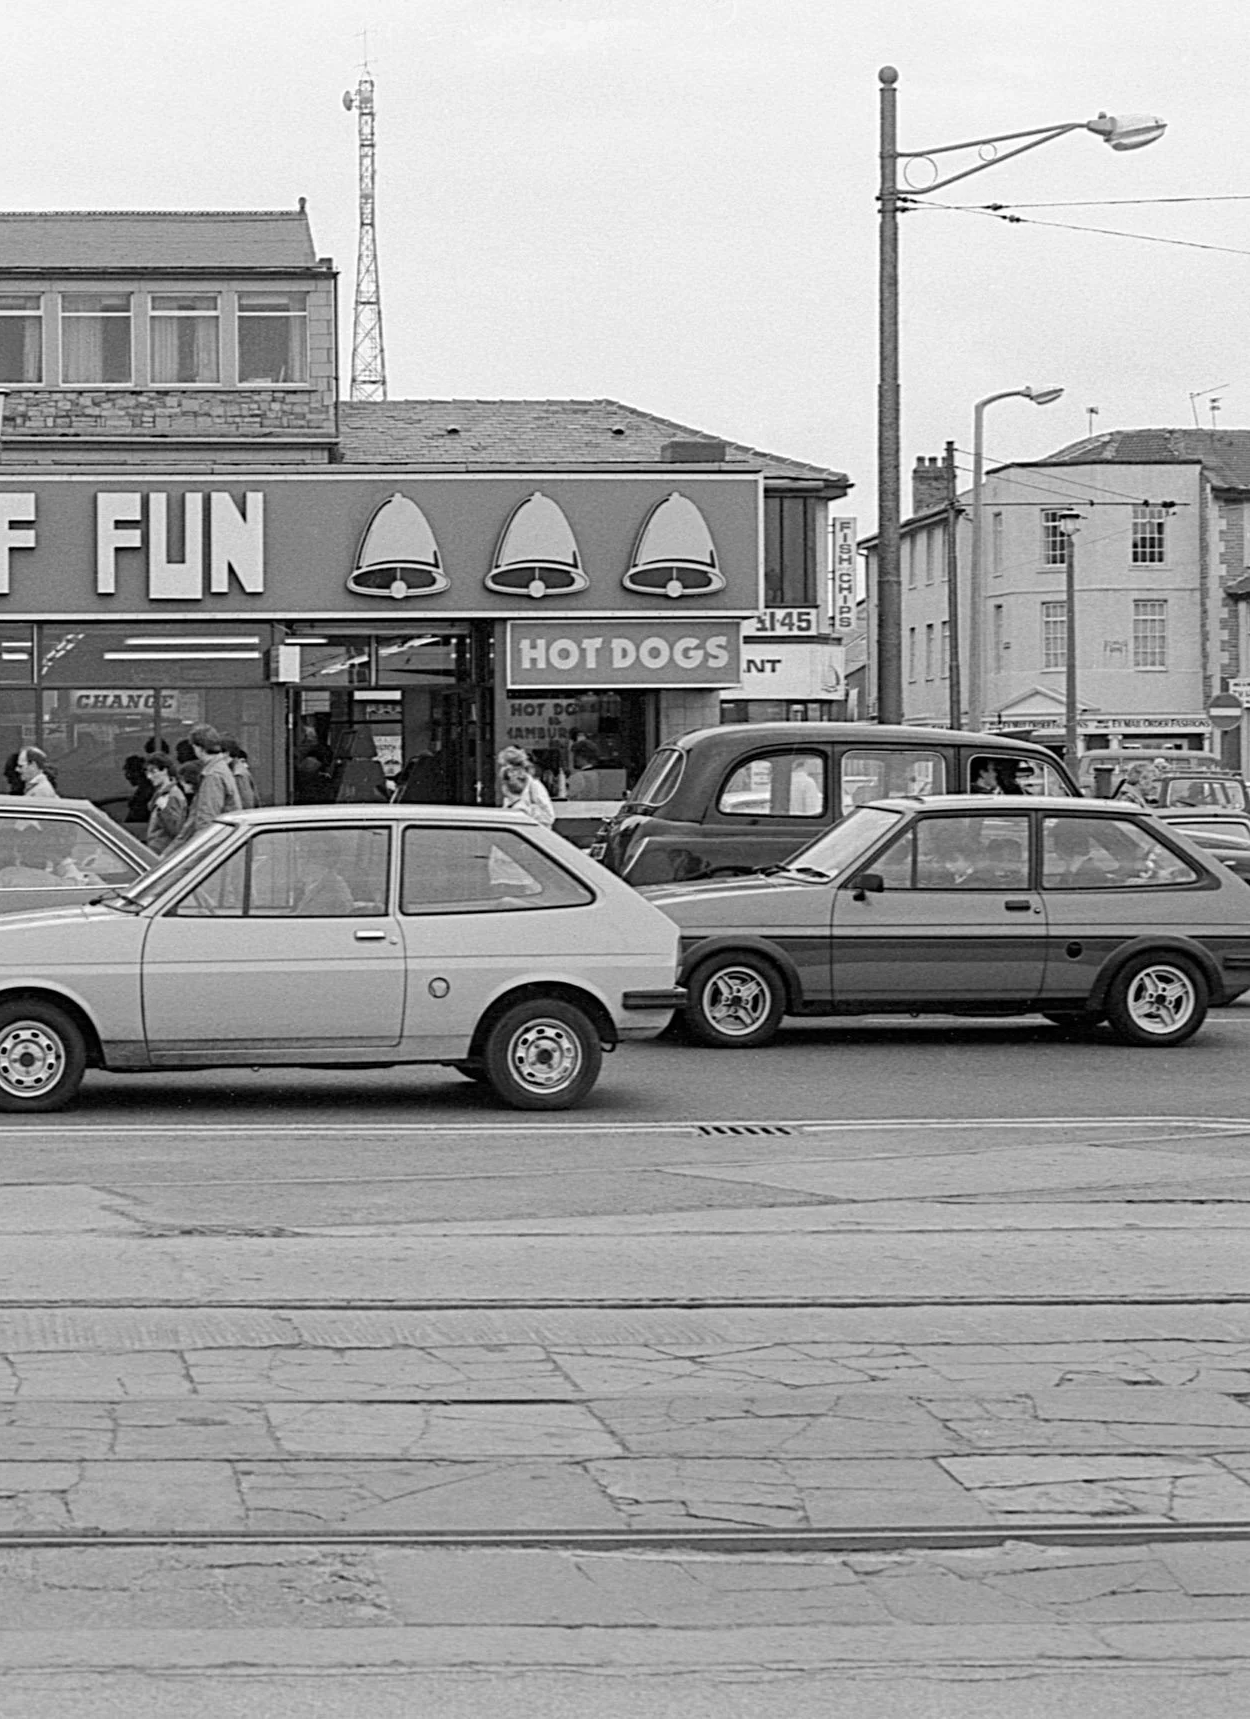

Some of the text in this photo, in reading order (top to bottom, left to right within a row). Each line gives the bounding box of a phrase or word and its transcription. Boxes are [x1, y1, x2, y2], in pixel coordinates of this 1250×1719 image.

[96, 490, 265, 600] FUN
[838, 521, 853, 565] FISH
[838, 572, 853, 628] CHIPS
[519, 635, 730, 670] HOT DOGS
[742, 659, 782, 673] NT
[76, 693, 175, 709] CHANGE
[510, 703, 545, 716] HOT
